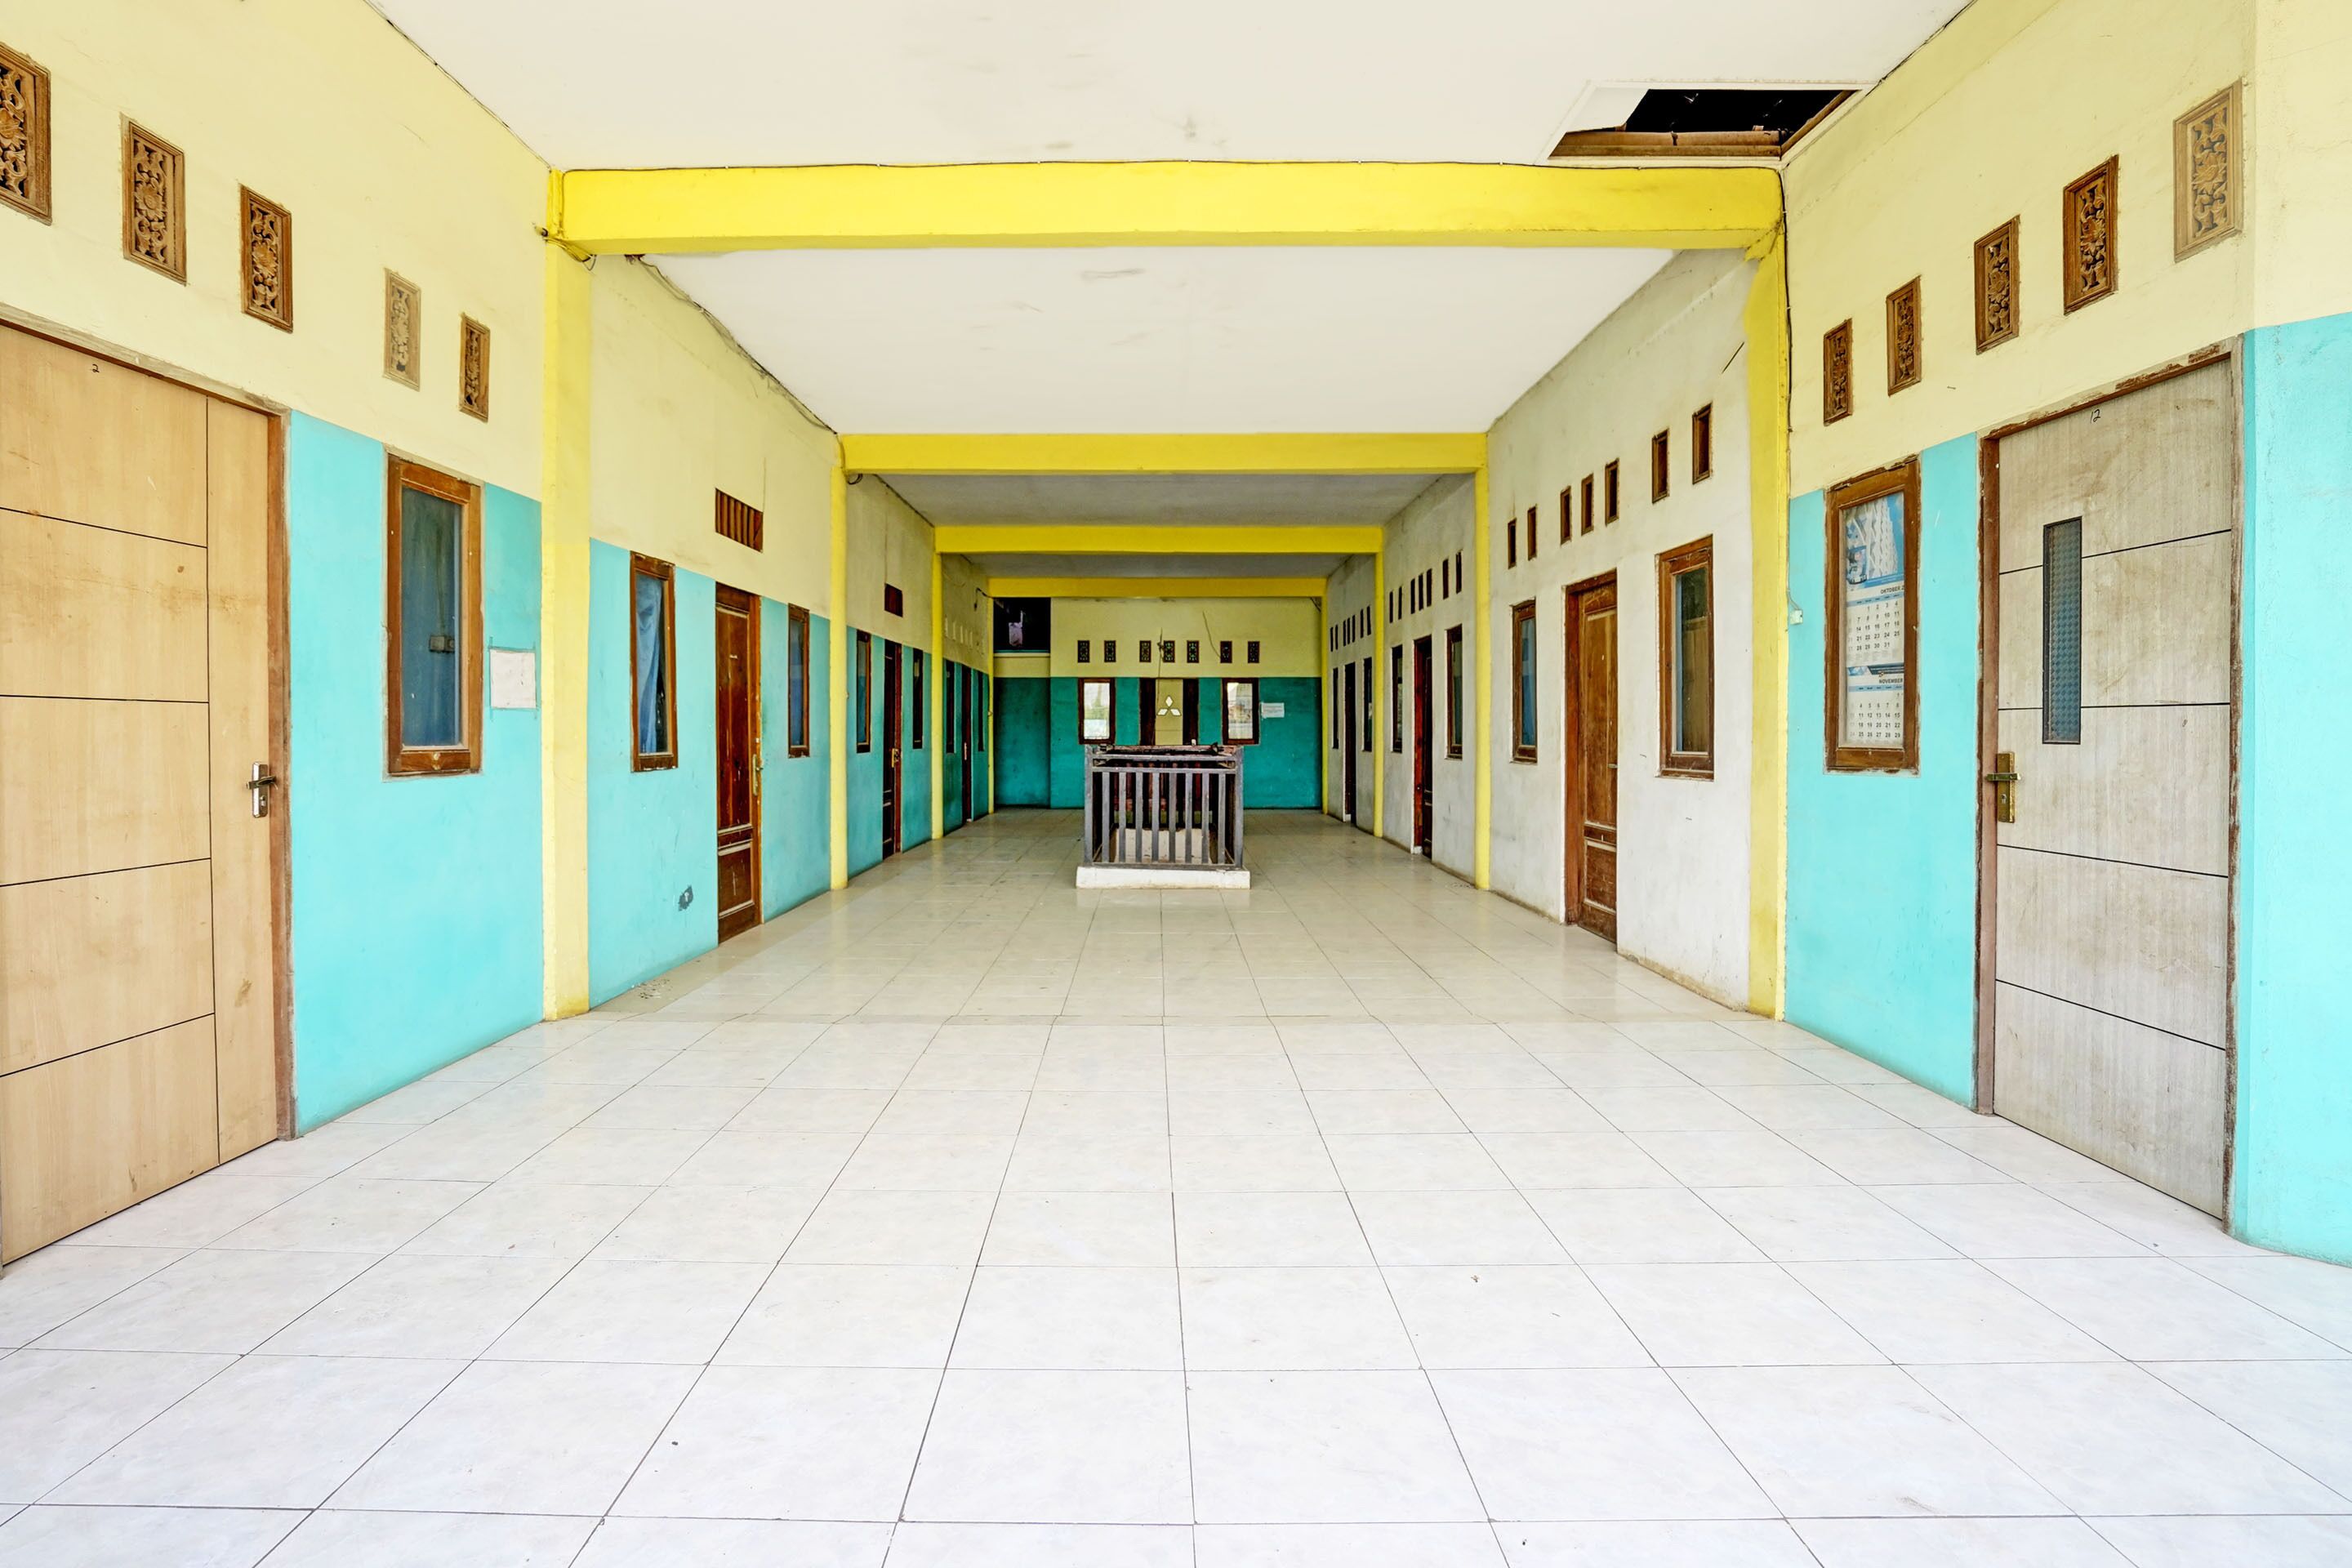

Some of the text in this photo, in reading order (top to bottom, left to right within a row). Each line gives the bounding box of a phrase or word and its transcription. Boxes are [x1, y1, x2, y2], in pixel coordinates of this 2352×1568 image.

[92, 363, 100, 373] 2
[2091, 409, 2101, 424] 12
[1881, 586, 1900, 595] OKTOBER
